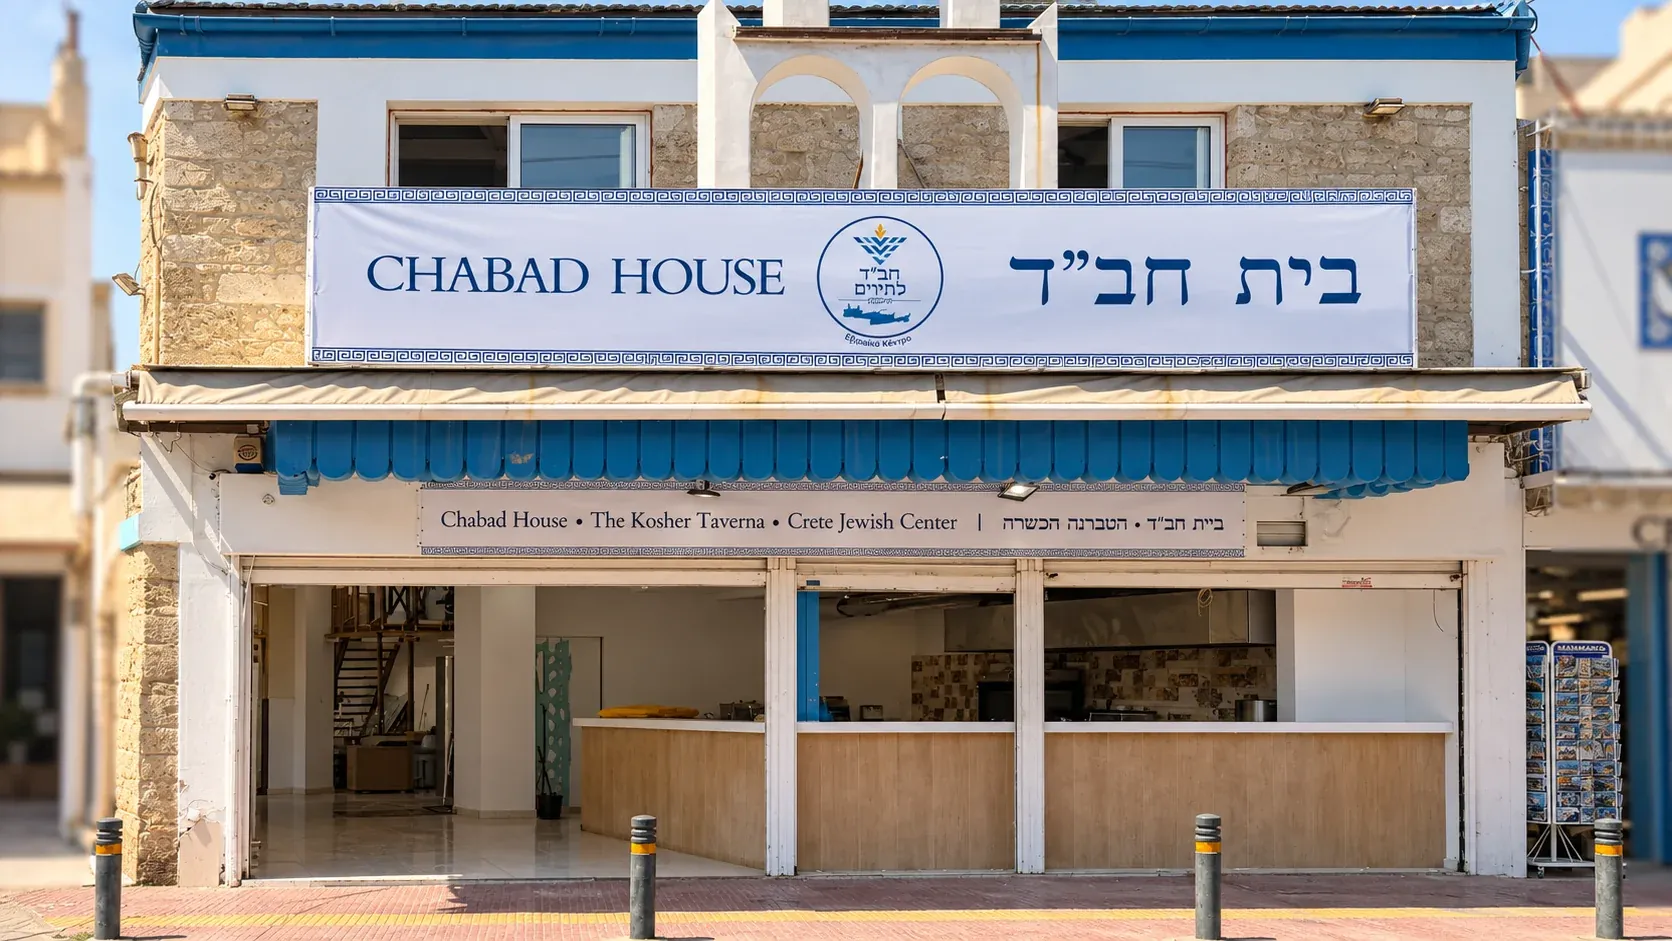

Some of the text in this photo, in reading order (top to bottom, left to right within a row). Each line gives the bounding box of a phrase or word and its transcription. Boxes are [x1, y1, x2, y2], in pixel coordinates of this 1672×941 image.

[367, 254, 786, 296] CHABAD HOUSE
[1235, 255, 1362, 306] בית
[440, 510, 958, 533] Chabad House The Kosher Taverna Crete Jewish Center
[1003, 517, 1060, 531] הכשרה
[1067, 517, 1128, 531] הטברנה
